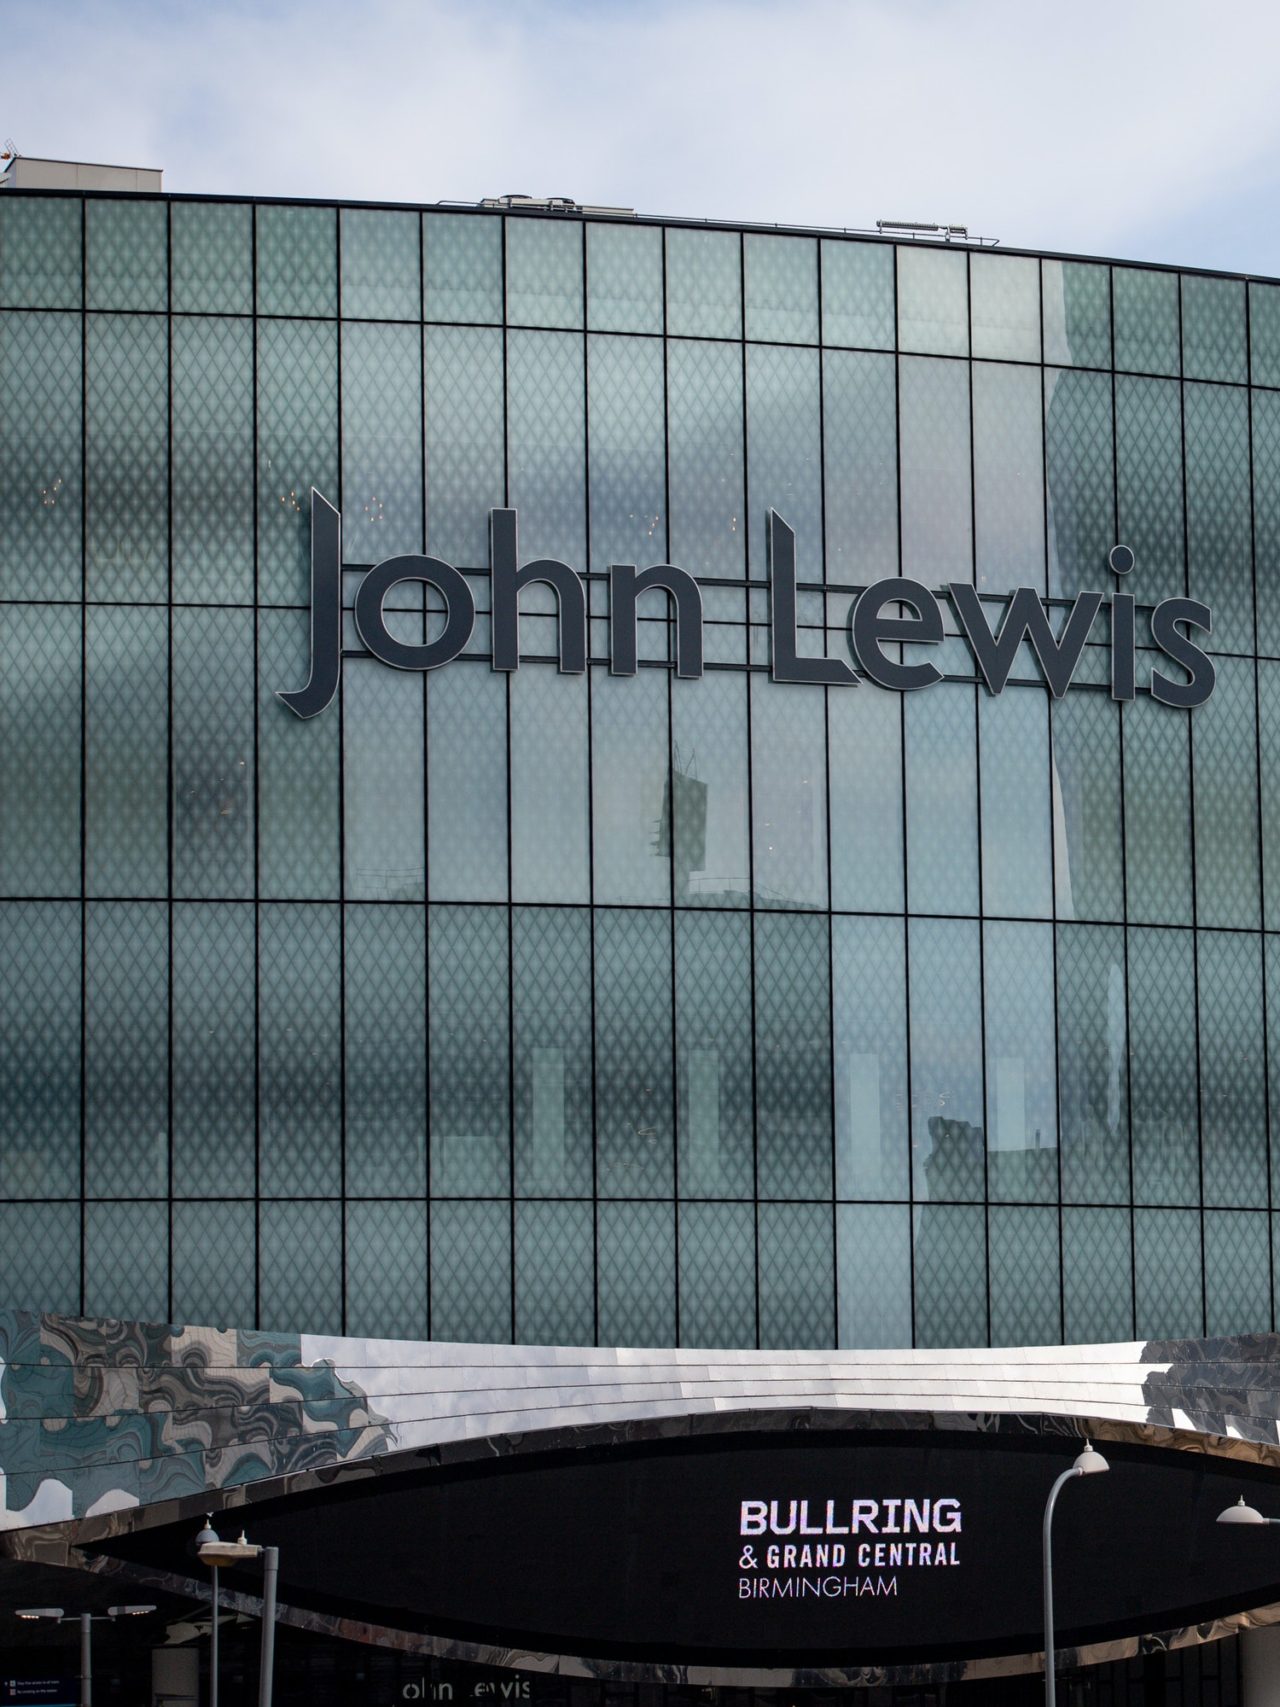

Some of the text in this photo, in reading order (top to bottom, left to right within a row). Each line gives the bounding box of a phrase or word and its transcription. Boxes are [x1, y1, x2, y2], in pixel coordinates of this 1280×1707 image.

[275, 486, 1217, 719] John Lewis
[740, 1499, 962, 1535] BULLRING
[739, 1542, 961, 1569] & GRAND CENTRAL
[738, 1576, 898, 1598] BIRMINGHAM
